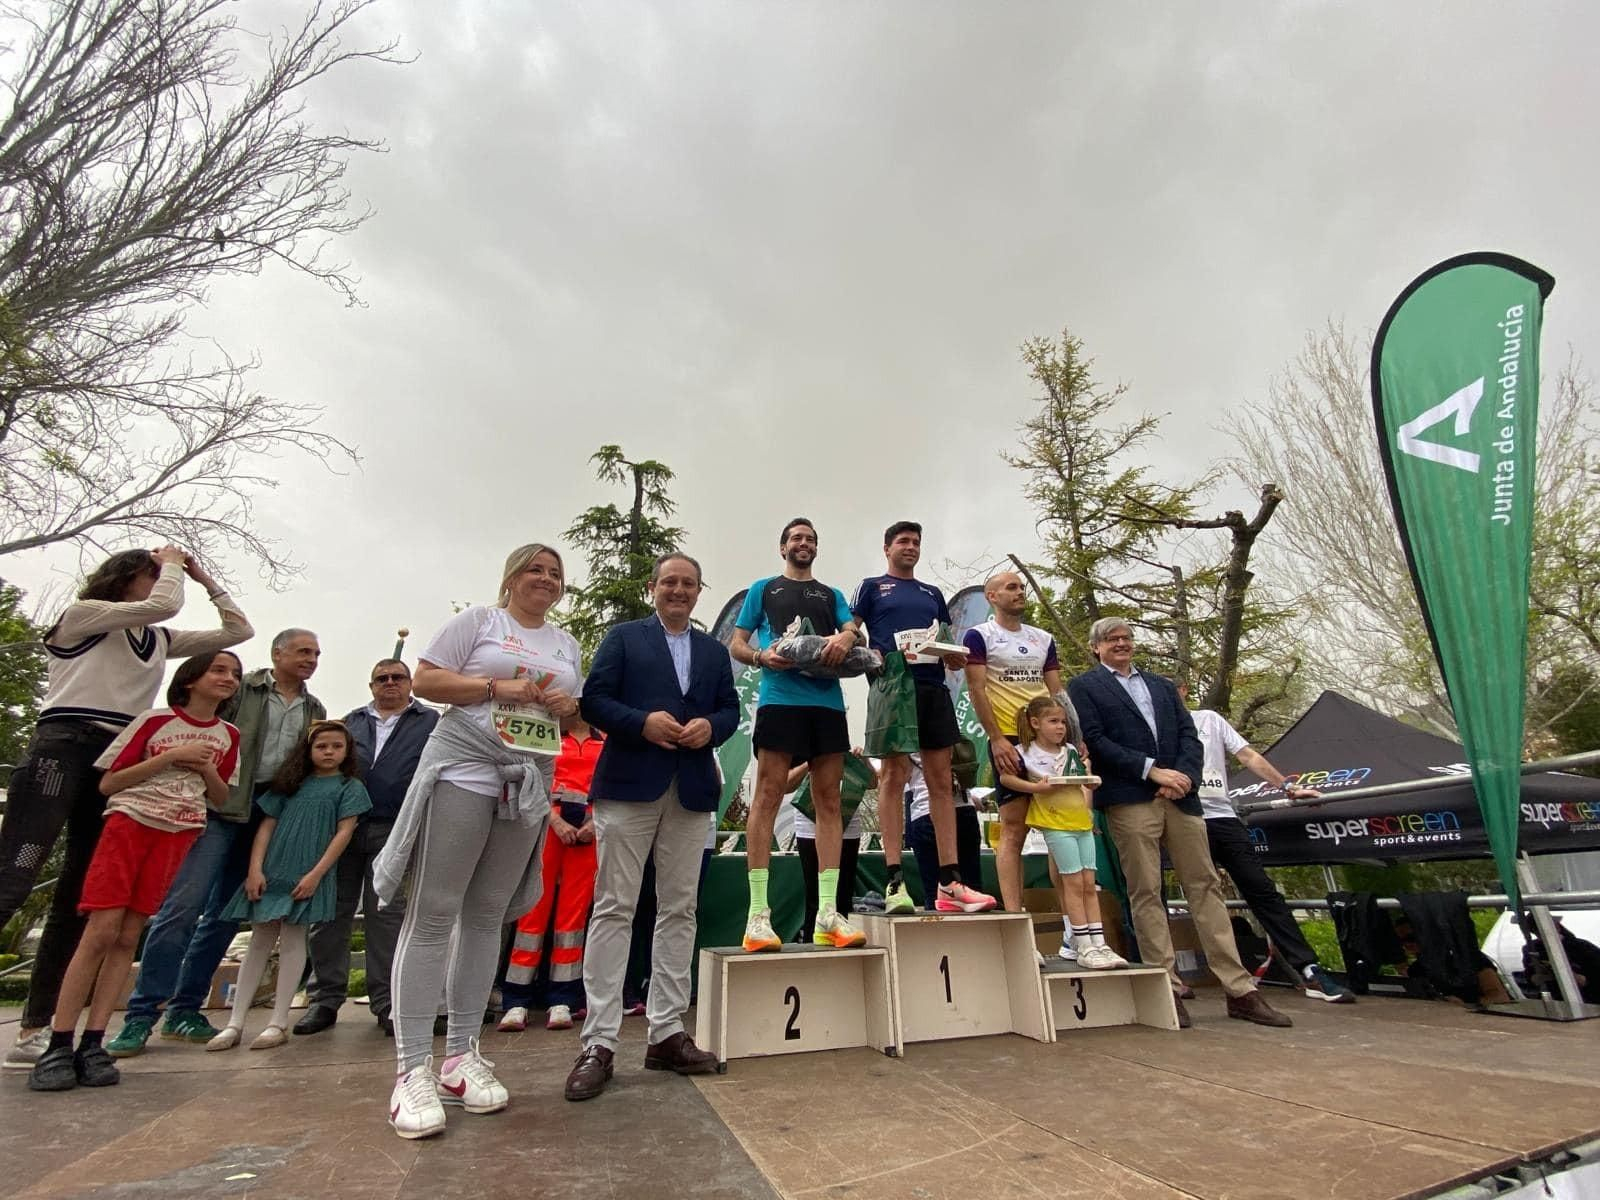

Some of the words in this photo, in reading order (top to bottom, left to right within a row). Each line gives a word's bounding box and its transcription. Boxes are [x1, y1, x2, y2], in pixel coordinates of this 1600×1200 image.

[1497, 303, 1524, 419] Andalucía
[1492, 425, 1514, 454] de
[1491, 459, 1514, 526] Junta
[510, 719, 557, 741] 5781
[1305, 810, 1462, 845] superscreen
[939, 955, 952, 1003] 1
[1070, 977, 1087, 1021] 3
[783, 985, 801, 1041] 2
